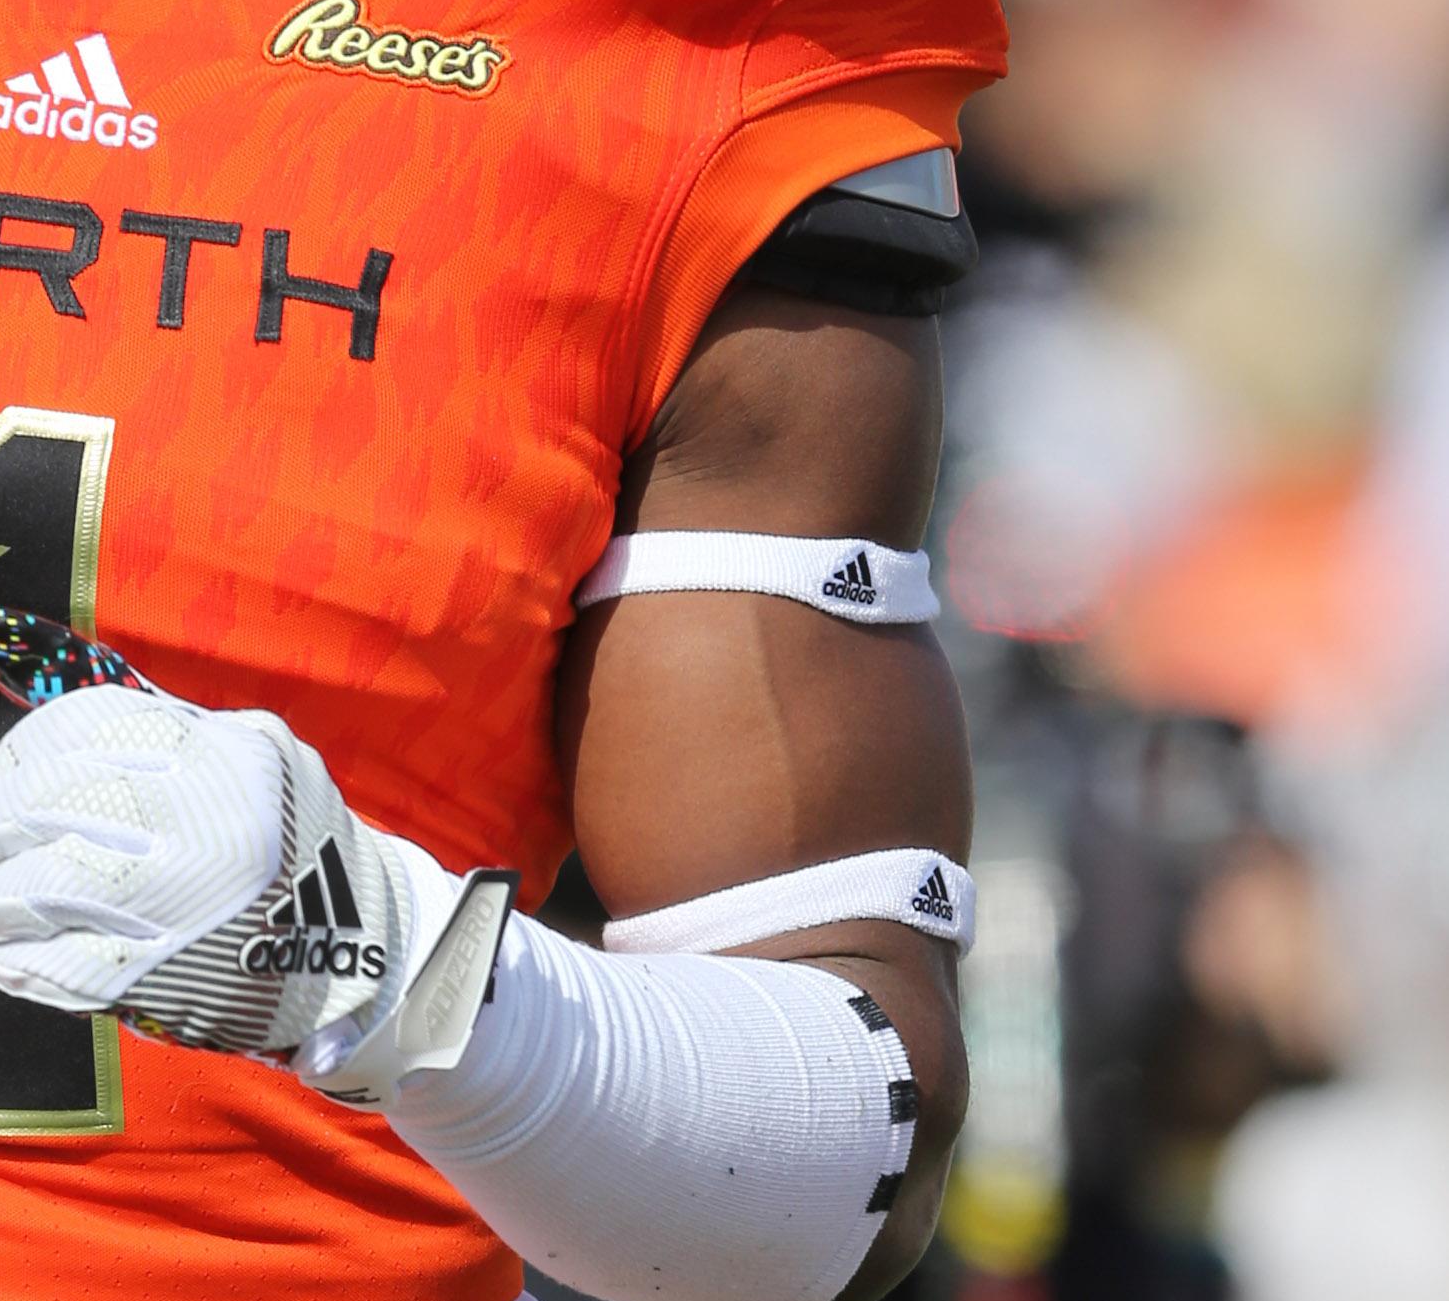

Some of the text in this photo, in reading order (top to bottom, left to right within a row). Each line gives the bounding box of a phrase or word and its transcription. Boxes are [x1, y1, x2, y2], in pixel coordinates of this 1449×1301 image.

[823, 579, 877, 605] adidas
[912, 896, 953, 921] adidas
[243, 926, 386, 979] adidas
[424, 893, 495, 1043] ADIZERO
